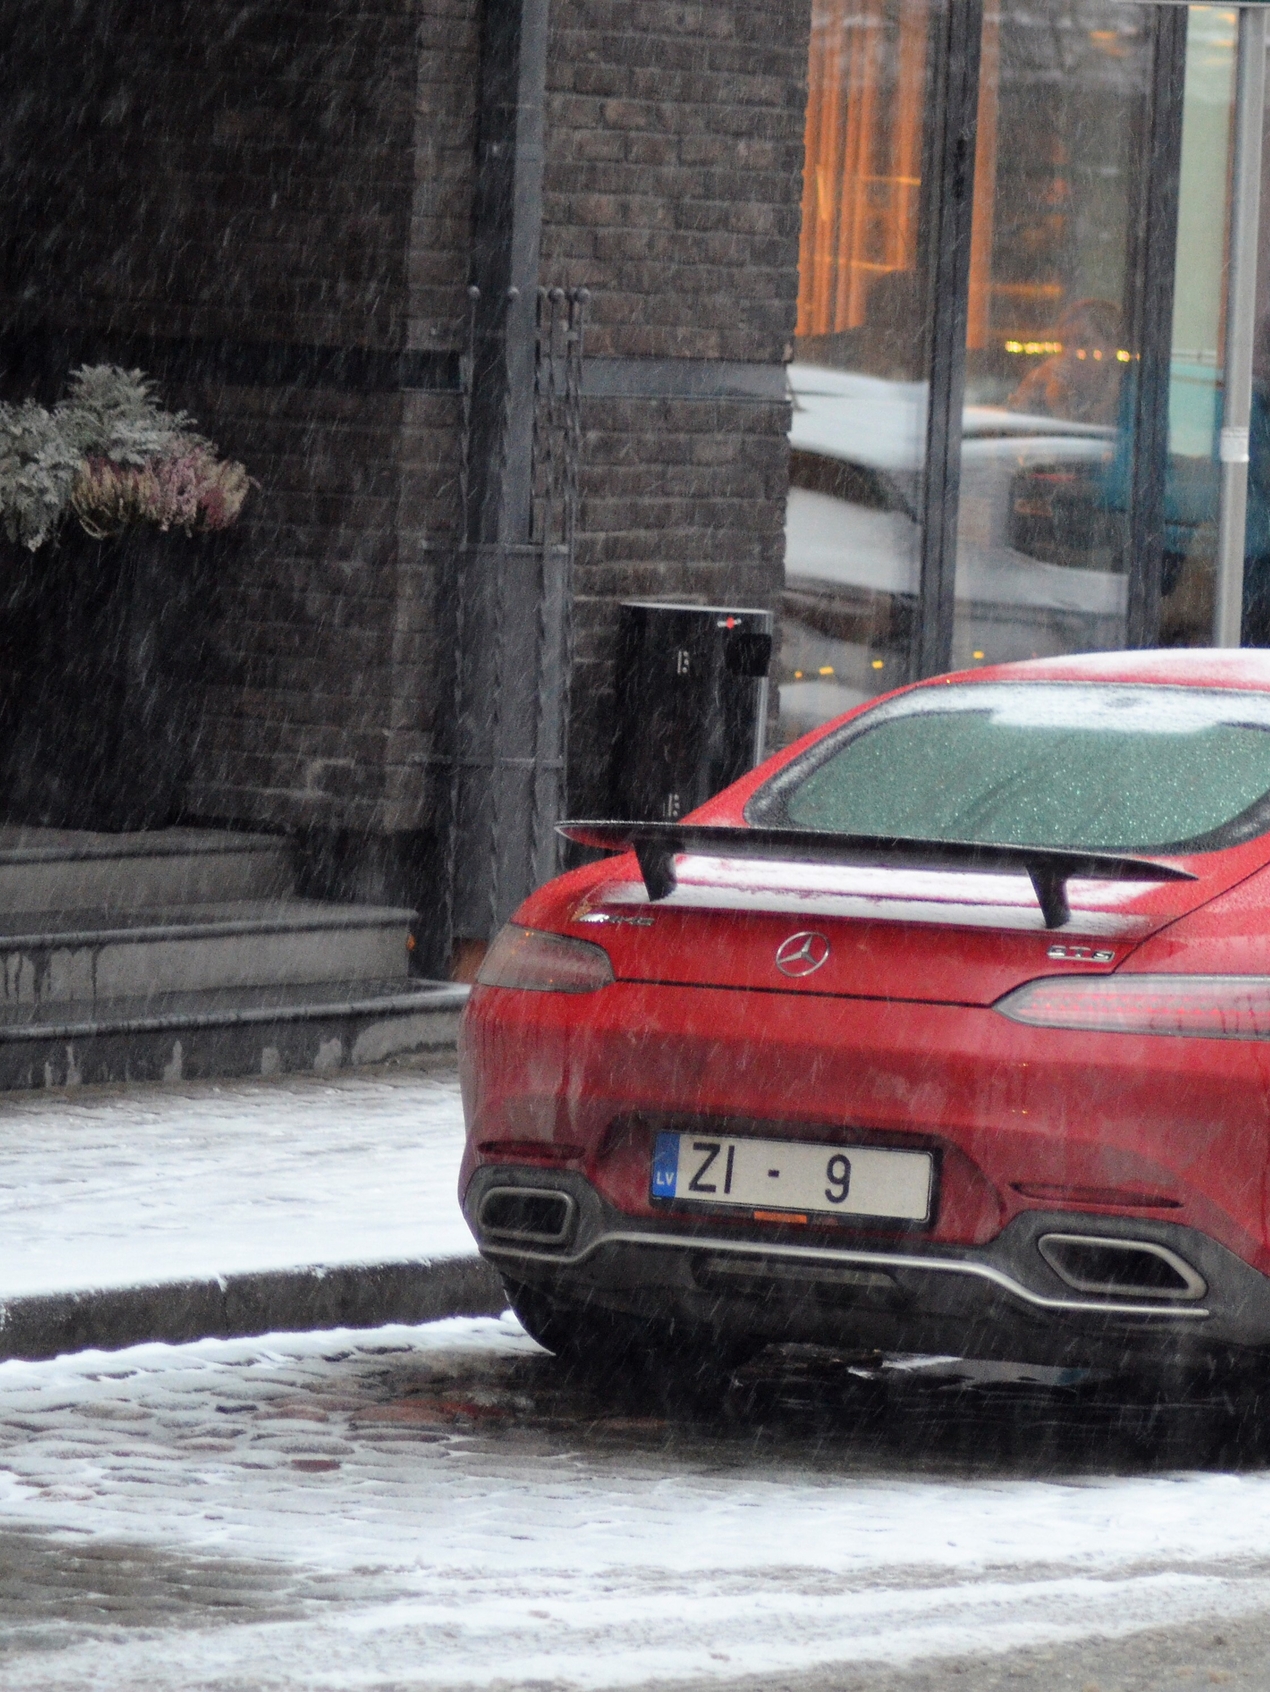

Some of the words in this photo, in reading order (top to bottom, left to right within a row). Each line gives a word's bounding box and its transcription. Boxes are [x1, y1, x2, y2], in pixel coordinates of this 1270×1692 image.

[656, 1171, 674, 1186] LV
[688, 1142, 735, 1194] ZI
[825, 1154, 851, 1204] 9
